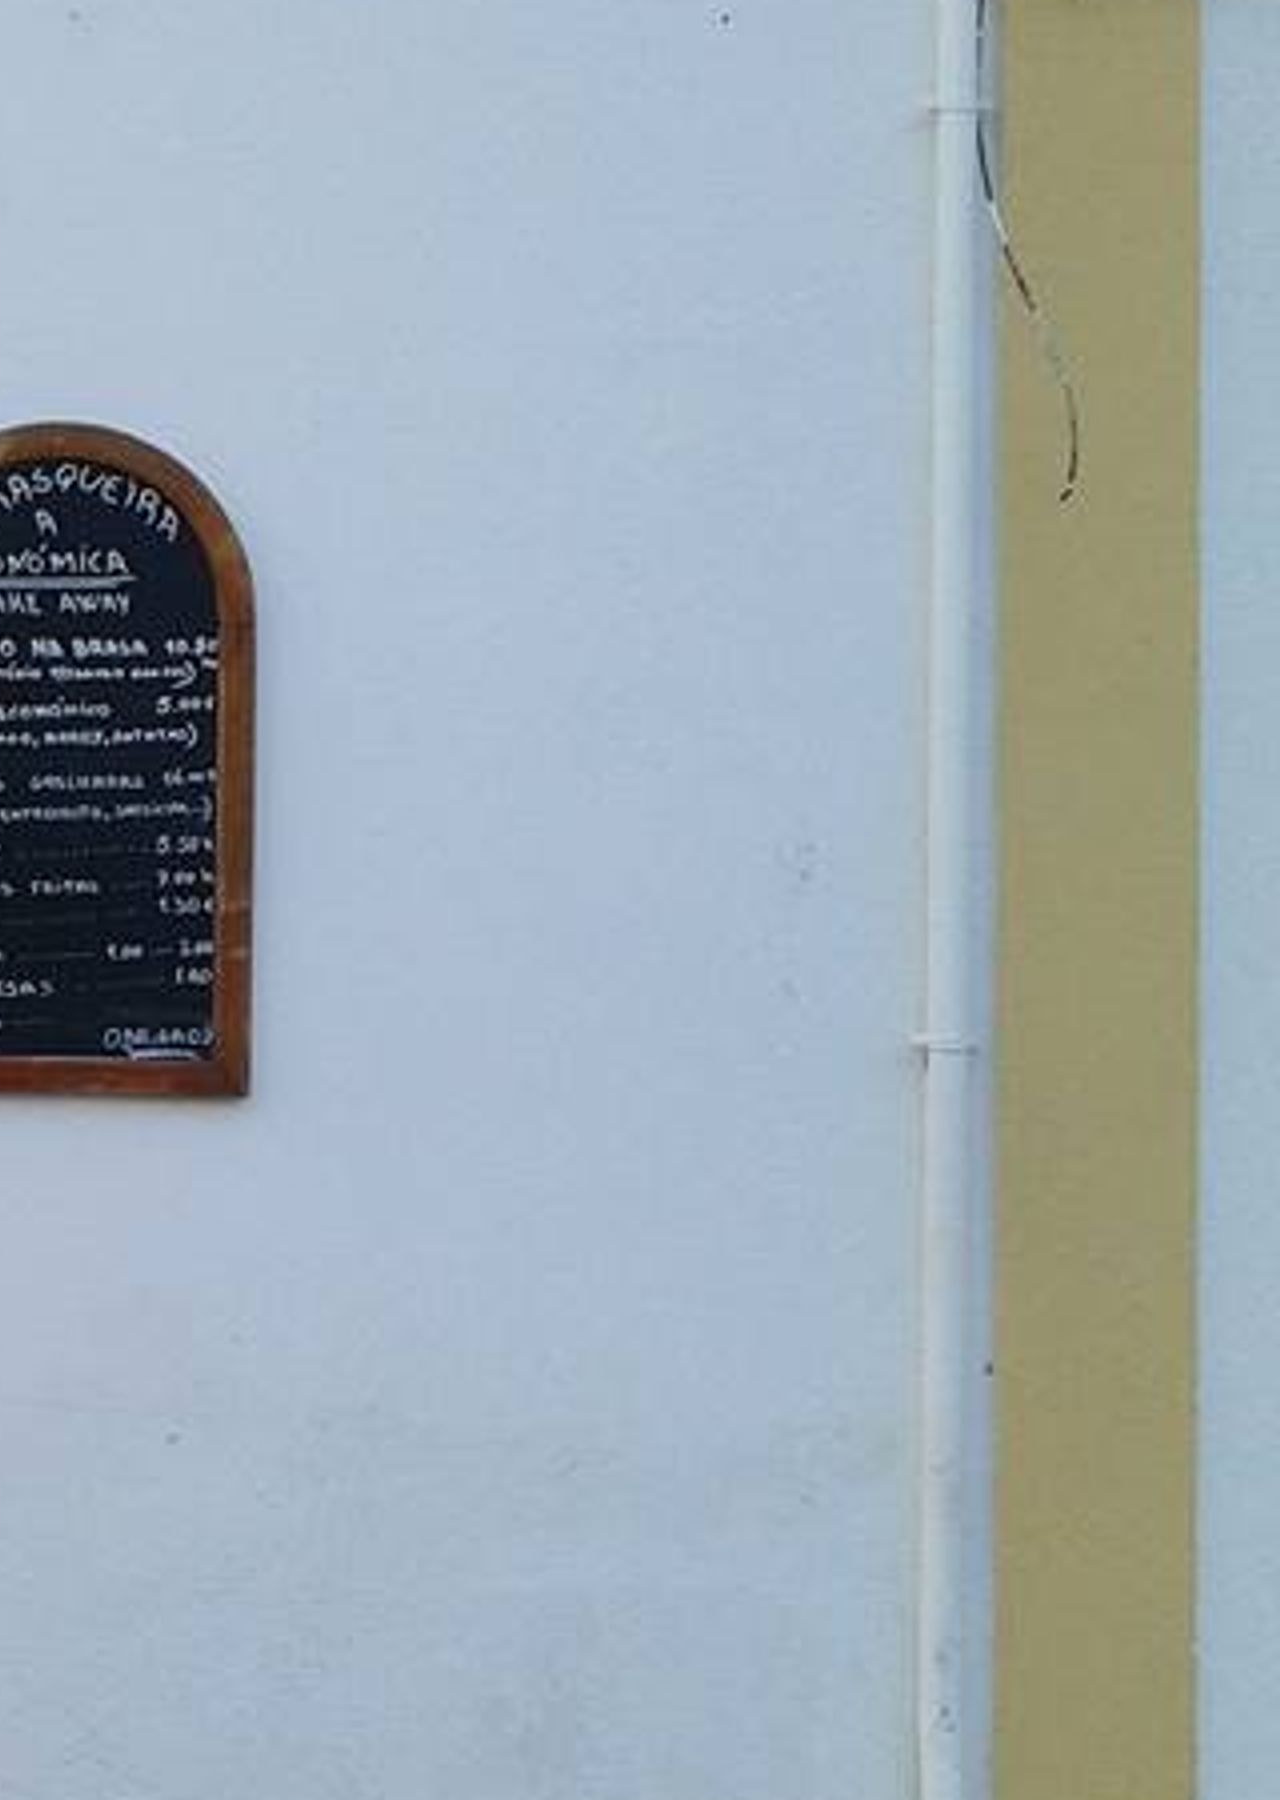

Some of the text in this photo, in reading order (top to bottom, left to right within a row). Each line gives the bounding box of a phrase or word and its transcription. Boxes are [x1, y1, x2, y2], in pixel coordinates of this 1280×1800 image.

[35, 509, 58, 537] A
[59, 591, 131, 615] AWAY
[31, 638, 65, 657] NA
[72, 637, 149, 658] BRASA
